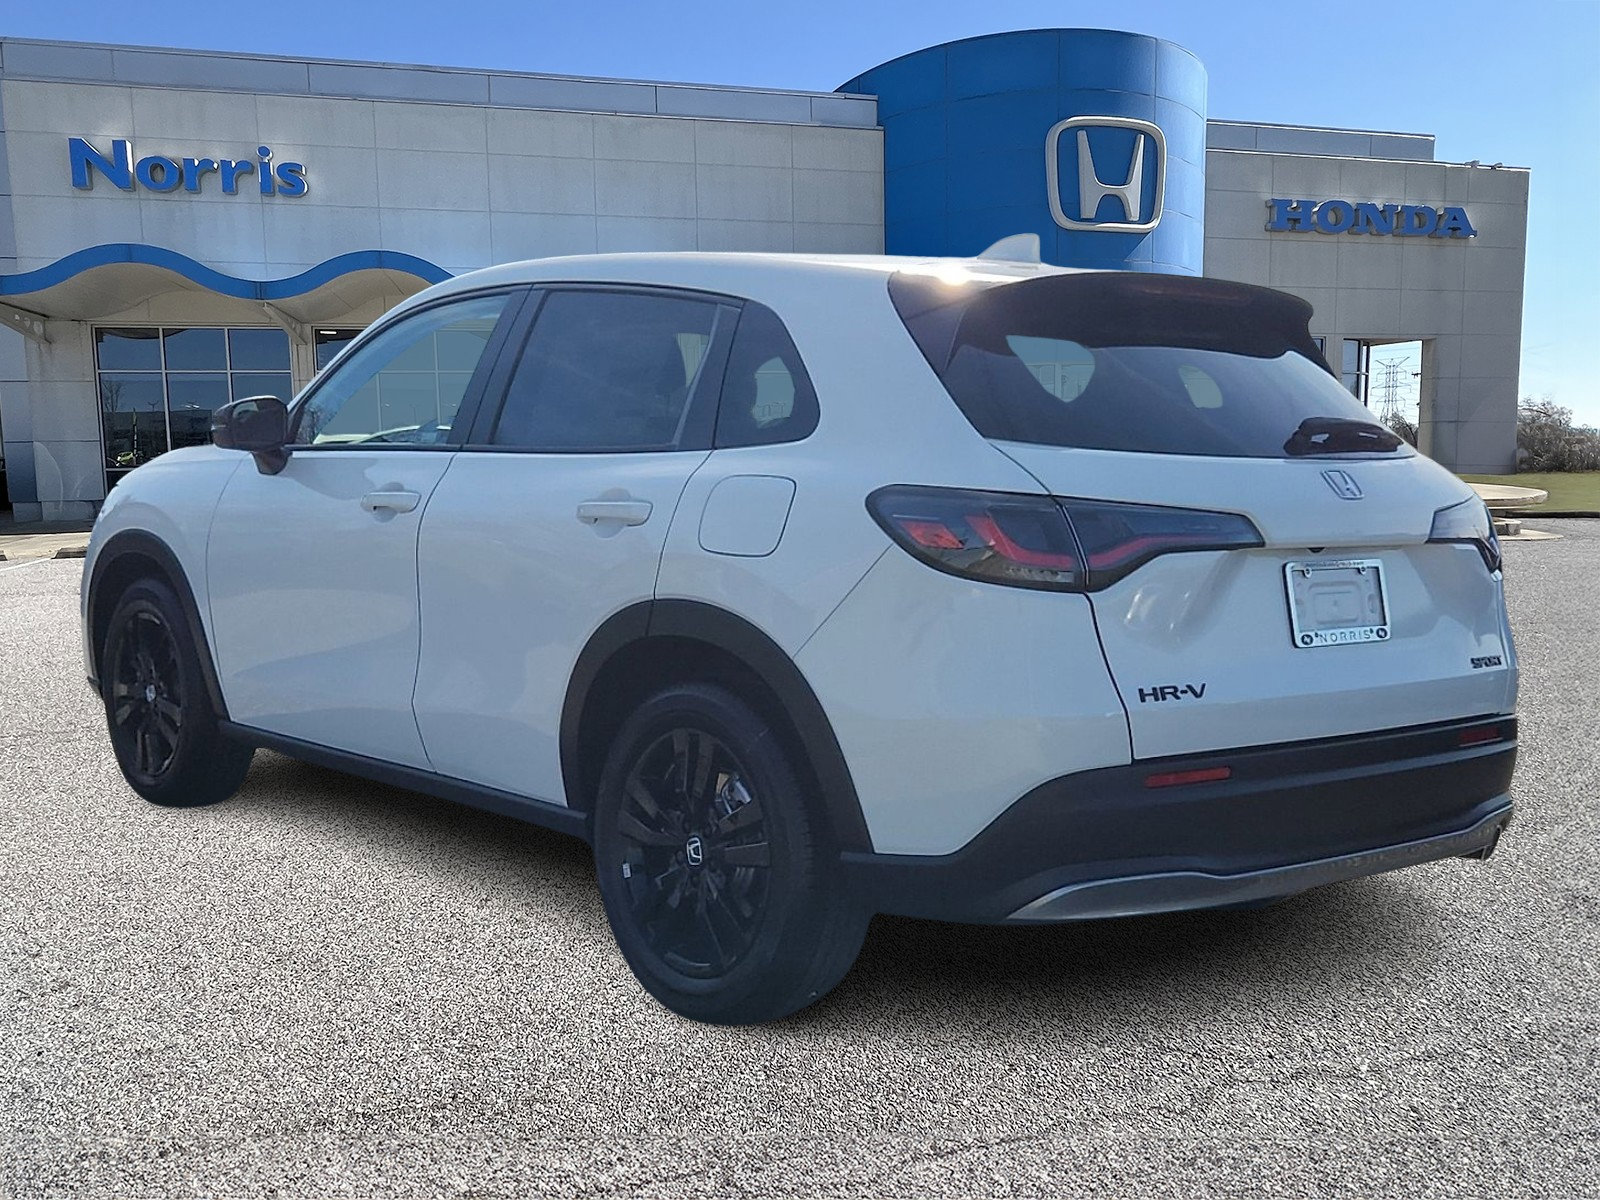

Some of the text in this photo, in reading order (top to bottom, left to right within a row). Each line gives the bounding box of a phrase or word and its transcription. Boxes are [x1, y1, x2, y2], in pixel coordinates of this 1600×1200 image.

[68, 137, 309, 197] Norris
[1265, 198, 1478, 239] HONDA
[1319, 628, 1371, 643] NORRIS
[1138, 683, 1206, 703] HR-V
